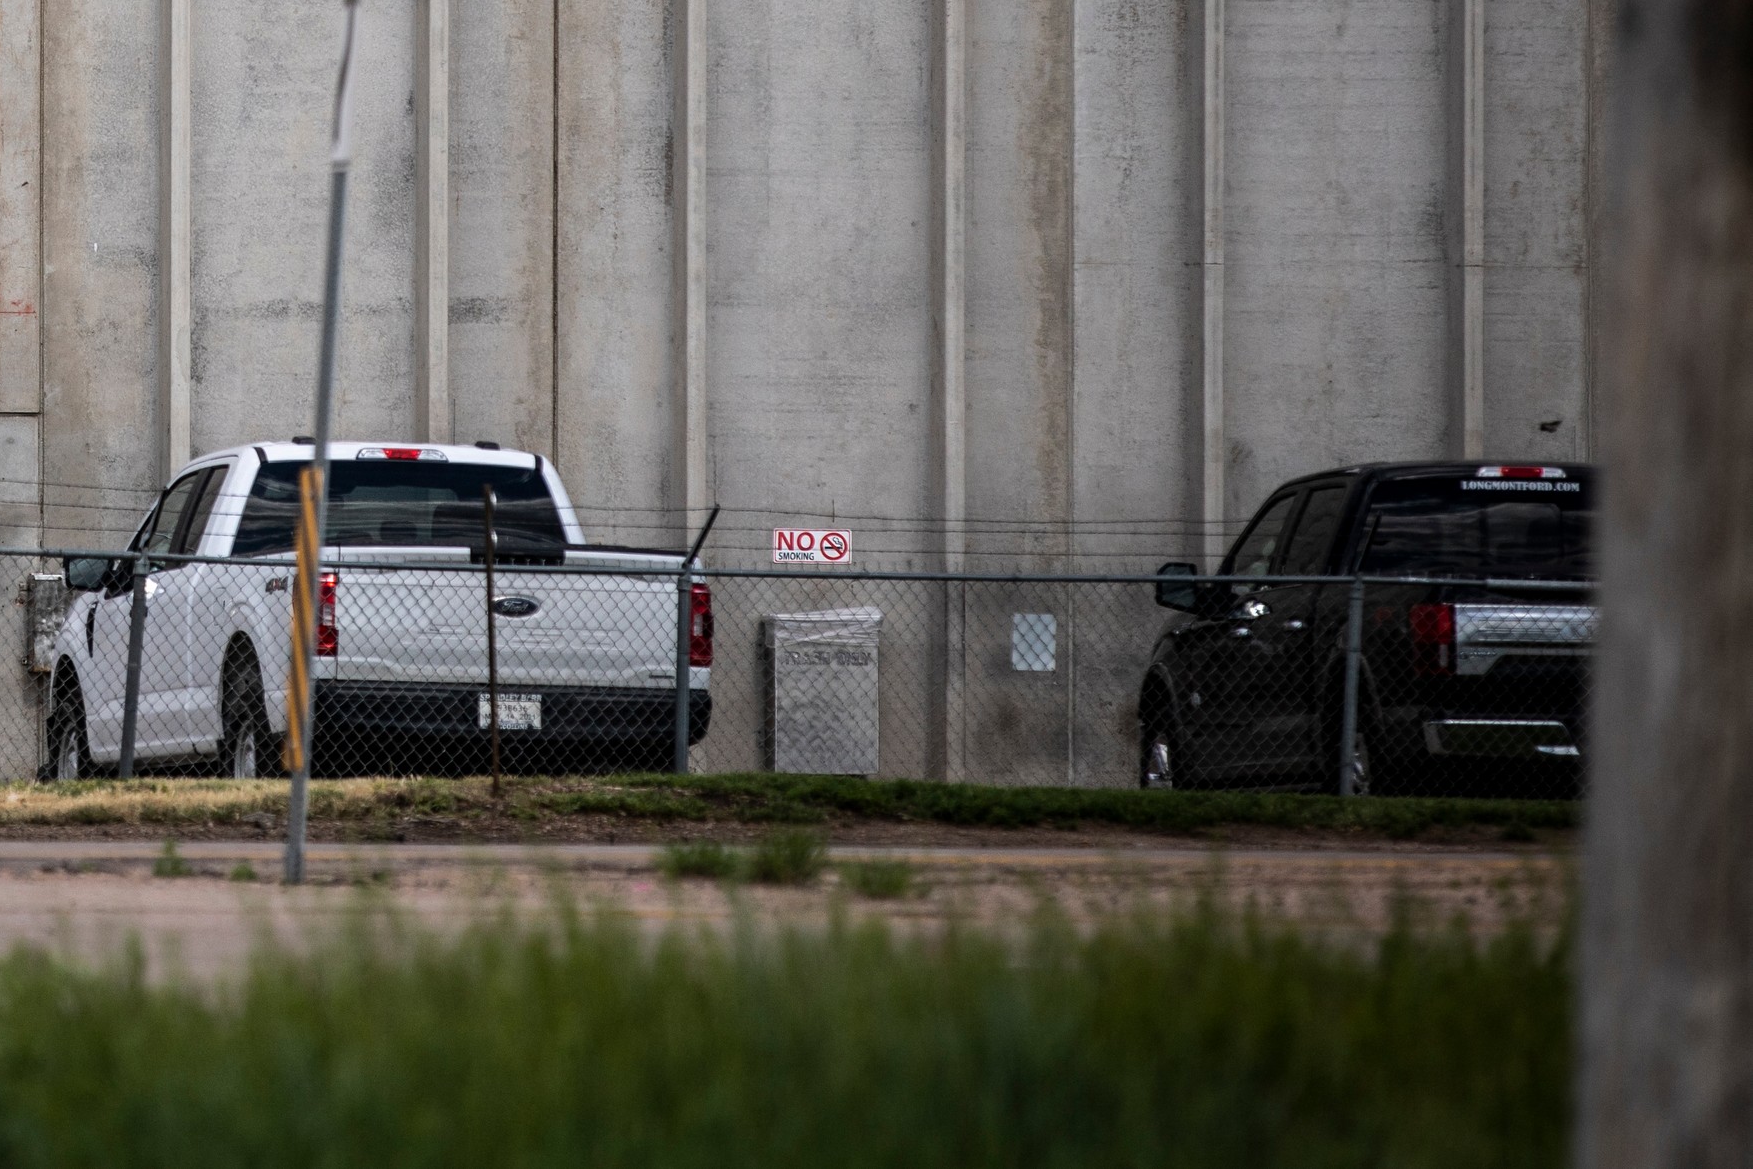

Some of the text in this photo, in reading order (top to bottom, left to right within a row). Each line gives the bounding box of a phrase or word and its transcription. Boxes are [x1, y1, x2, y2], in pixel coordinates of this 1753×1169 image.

[1461, 480, 1580, 492] LONGMONTFORD.COM
[777, 532, 816, 551] NO
[778, 552, 815, 561] SMOKING
